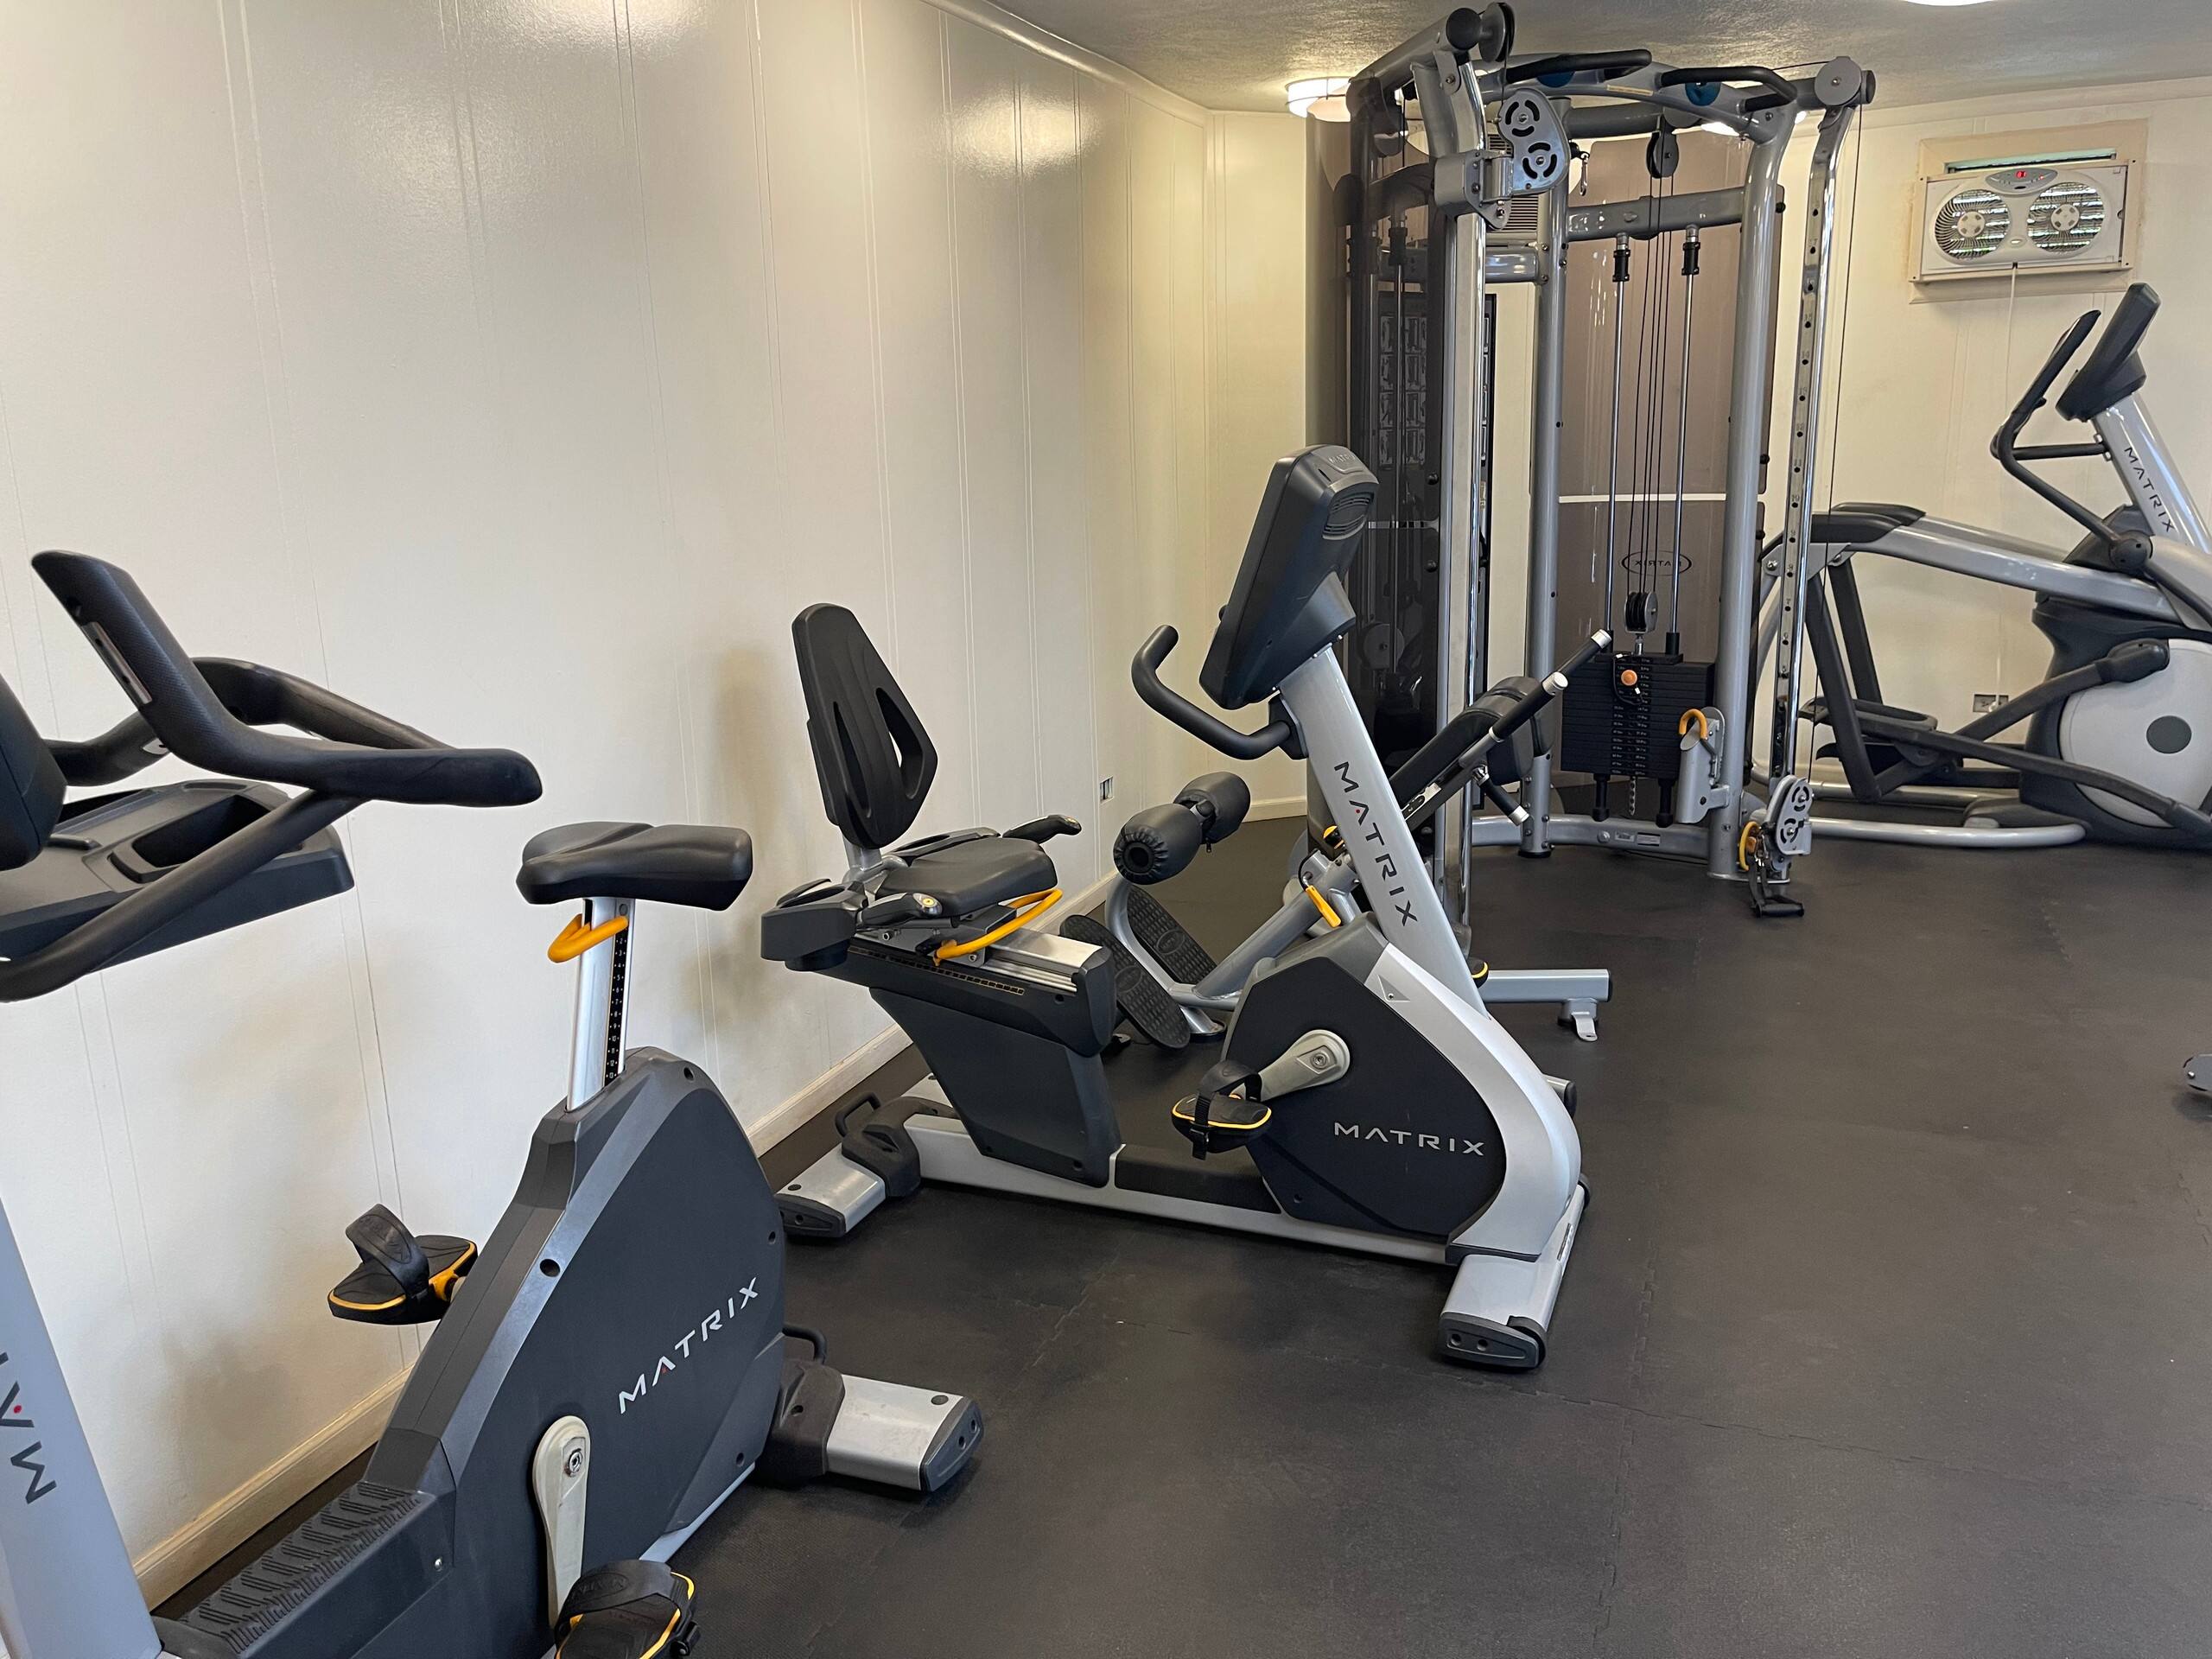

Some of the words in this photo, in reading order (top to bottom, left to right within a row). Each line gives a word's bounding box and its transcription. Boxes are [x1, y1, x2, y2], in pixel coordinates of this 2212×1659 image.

[2124, 447, 2176, 533] MATRIX
[1334, 761, 1418, 927] MATRIX
[1334, 1122, 1484, 1156] MATRIX
[619, 1277, 759, 1414] MATRIX
